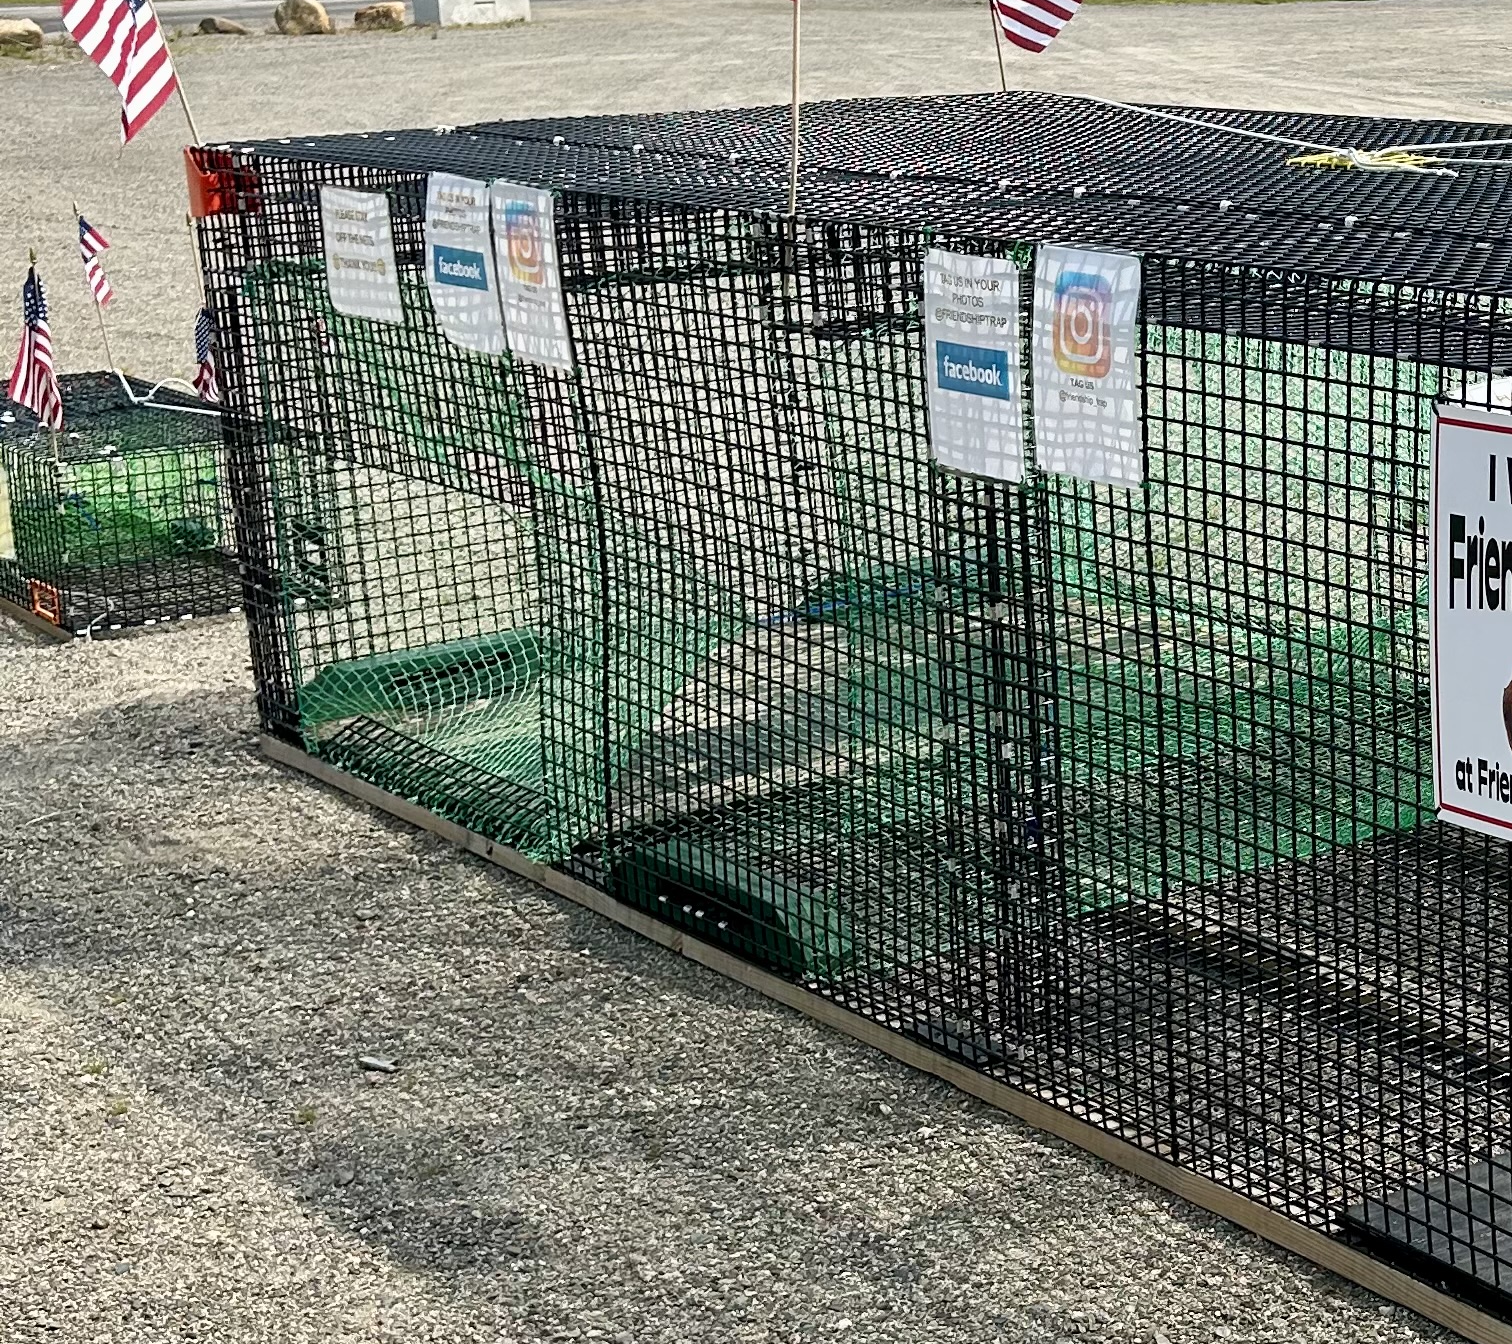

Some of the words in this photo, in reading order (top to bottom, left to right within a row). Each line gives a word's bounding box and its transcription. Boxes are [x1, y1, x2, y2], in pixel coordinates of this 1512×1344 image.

[438, 255, 482, 281] facebook
[940, 272, 953, 286] TAG
[953, 275, 963, 287] US
[964, 277, 973, 289] IN
[974, 278, 1000, 292] YOUR
[952, 292, 984, 308] PHOTOS
[935, 307, 1007, 329] @FRIENDSHIPTRAP
[943, 355, 1003, 387] facebook
[1070, 377, 1085, 389] TAG
[1488, 454, 1497, 502] I
[1455, 757, 1474, 794] at
